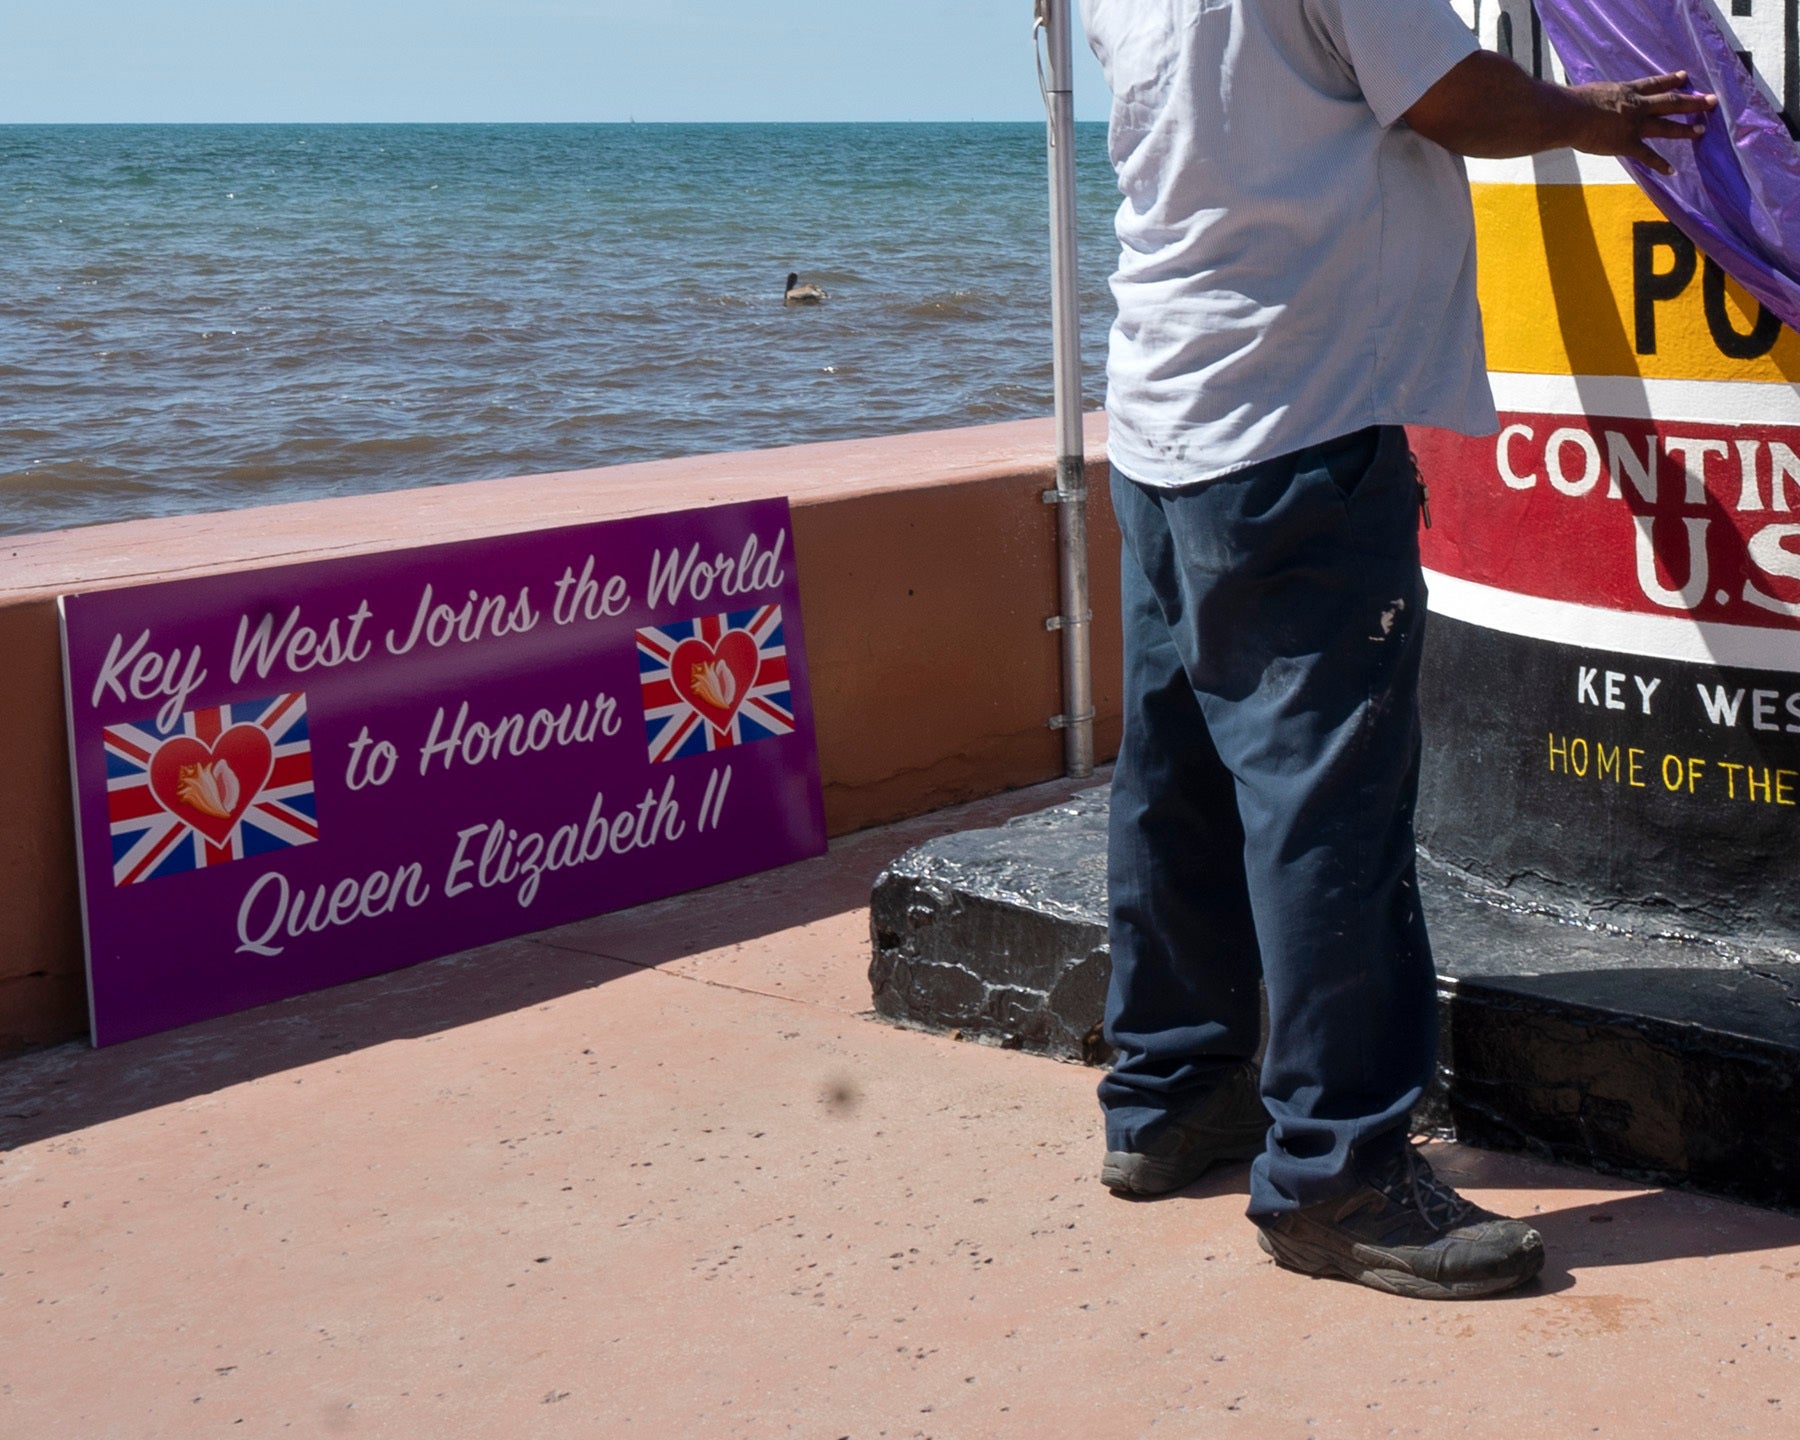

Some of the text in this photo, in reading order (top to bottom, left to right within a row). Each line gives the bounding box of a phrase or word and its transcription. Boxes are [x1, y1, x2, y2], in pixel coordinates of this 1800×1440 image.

[91, 528, 787, 733] Key West Joins the World
[1576, 666, 1662, 715] KEY
[344, 691, 622, 791] to Honour
[1547, 733, 1647, 789] HOME
[1661, 753, 1705, 794] OF
[1716, 762, 1798, 807] THE
[234, 863, 429, 957] Queen
[444, 774, 686, 908] Elizabeth
